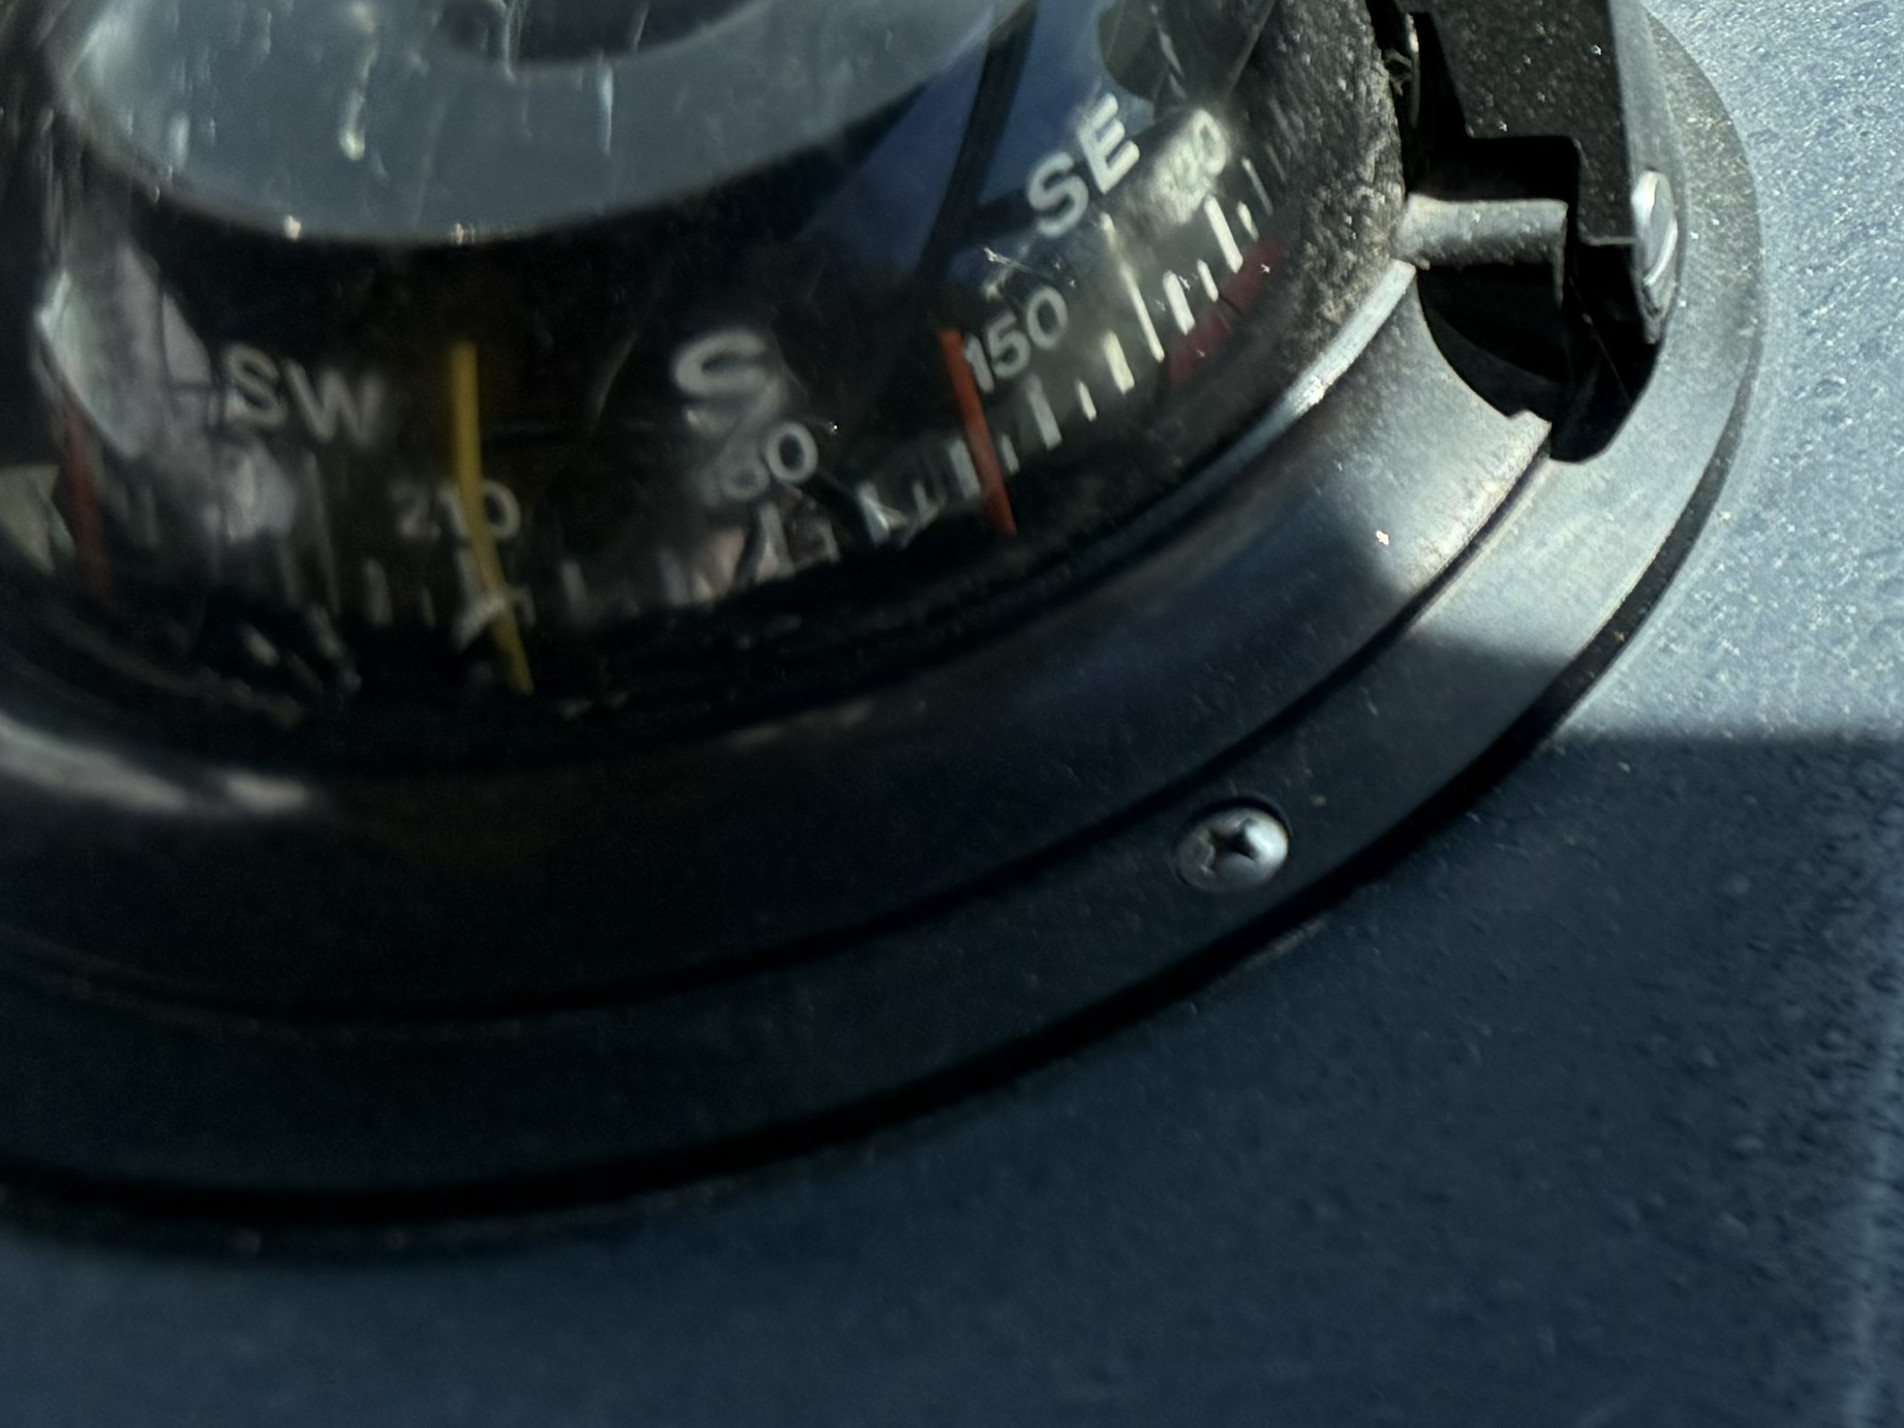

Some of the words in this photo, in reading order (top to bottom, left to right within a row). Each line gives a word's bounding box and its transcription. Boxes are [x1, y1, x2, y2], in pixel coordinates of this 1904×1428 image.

[1026, 92, 1140, 238] SE
[224, 344, 387, 441] SW
[674, 328, 788, 438] S
[964, 285, 1068, 394] 150
